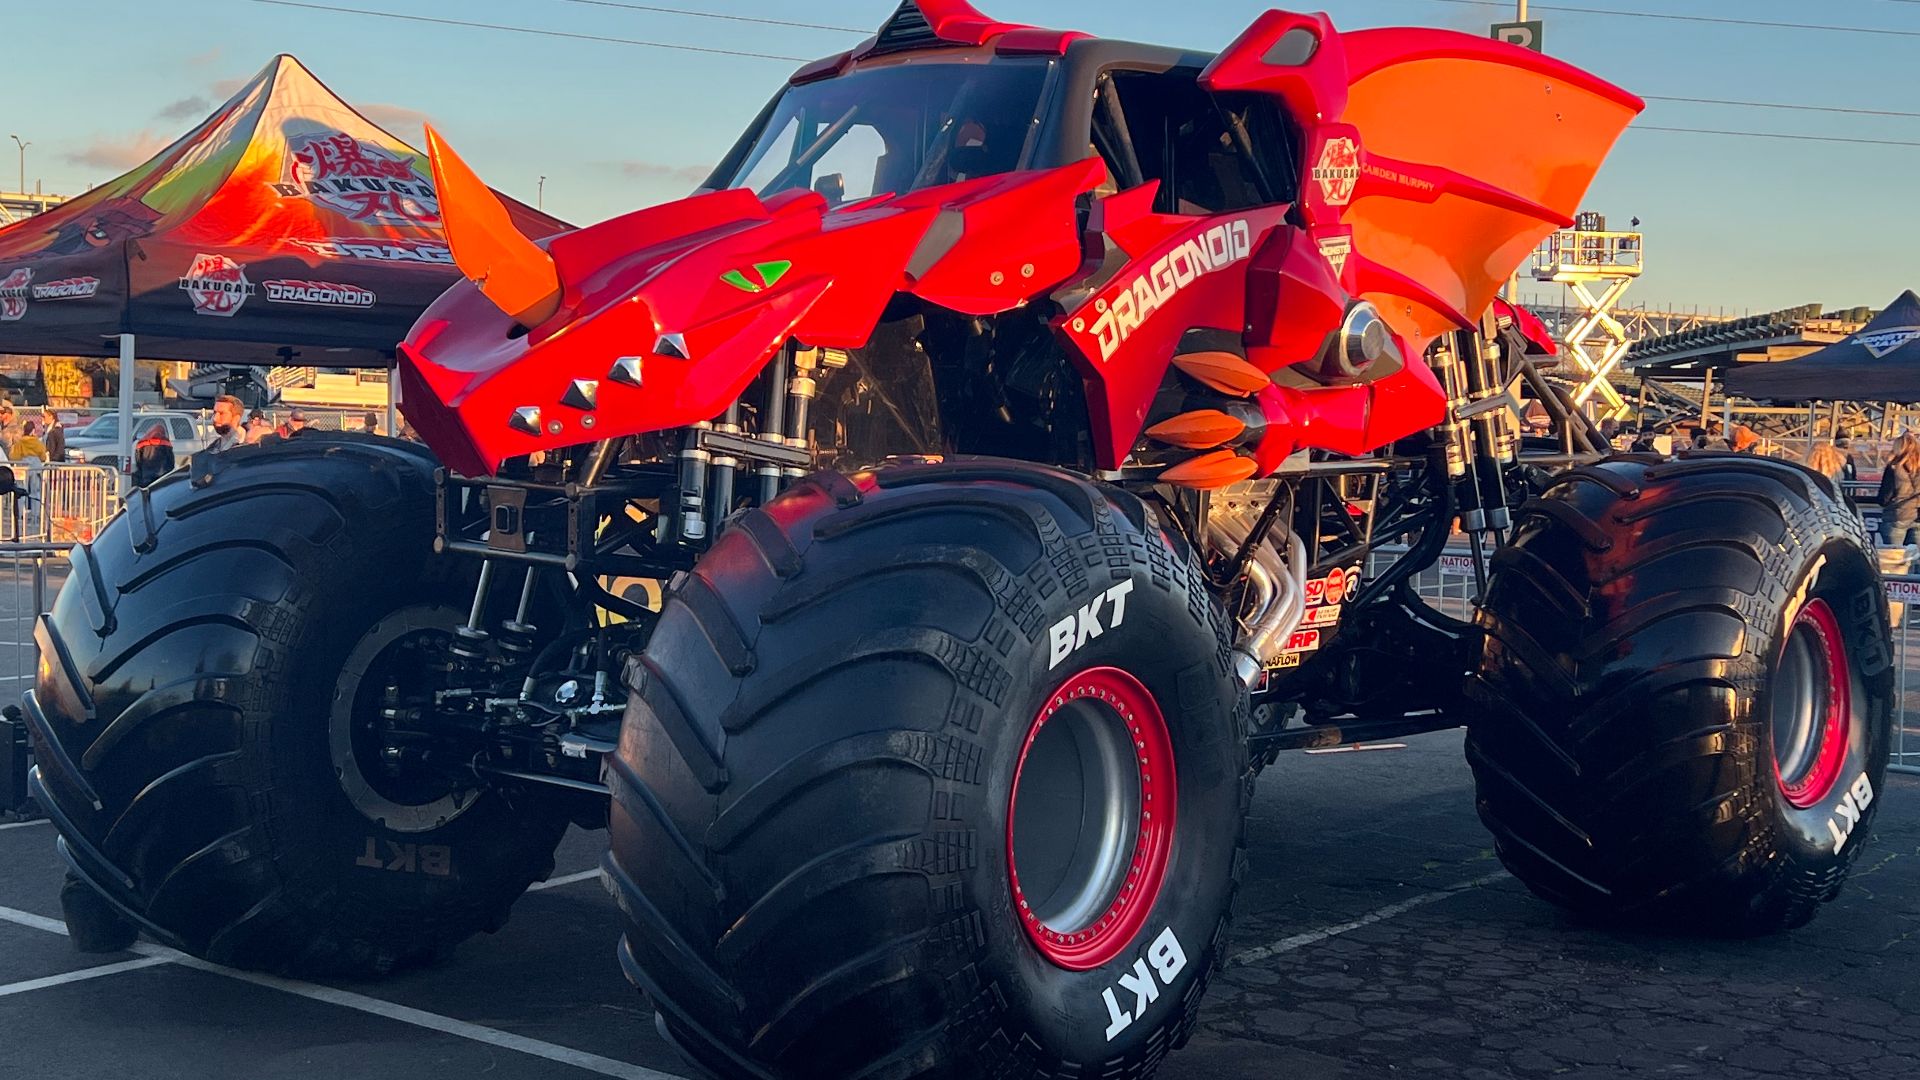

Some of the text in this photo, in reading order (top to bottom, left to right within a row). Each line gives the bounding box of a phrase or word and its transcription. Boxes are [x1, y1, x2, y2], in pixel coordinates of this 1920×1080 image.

[1361, 163, 1435, 192] CAMDEN MURPHY
[35, 281, 98, 299] DRAGONOID
[181, 280, 254, 295] BAKUGAN
[267, 284, 374, 305] DRAGONOID
[1089, 219, 1251, 363] DRAGONOID
[1049, 577, 1134, 671] BKT
[1827, 771, 1874, 857] BKT
[355, 836, 451, 876] BKT
[1101, 925, 1188, 1042] BKT
